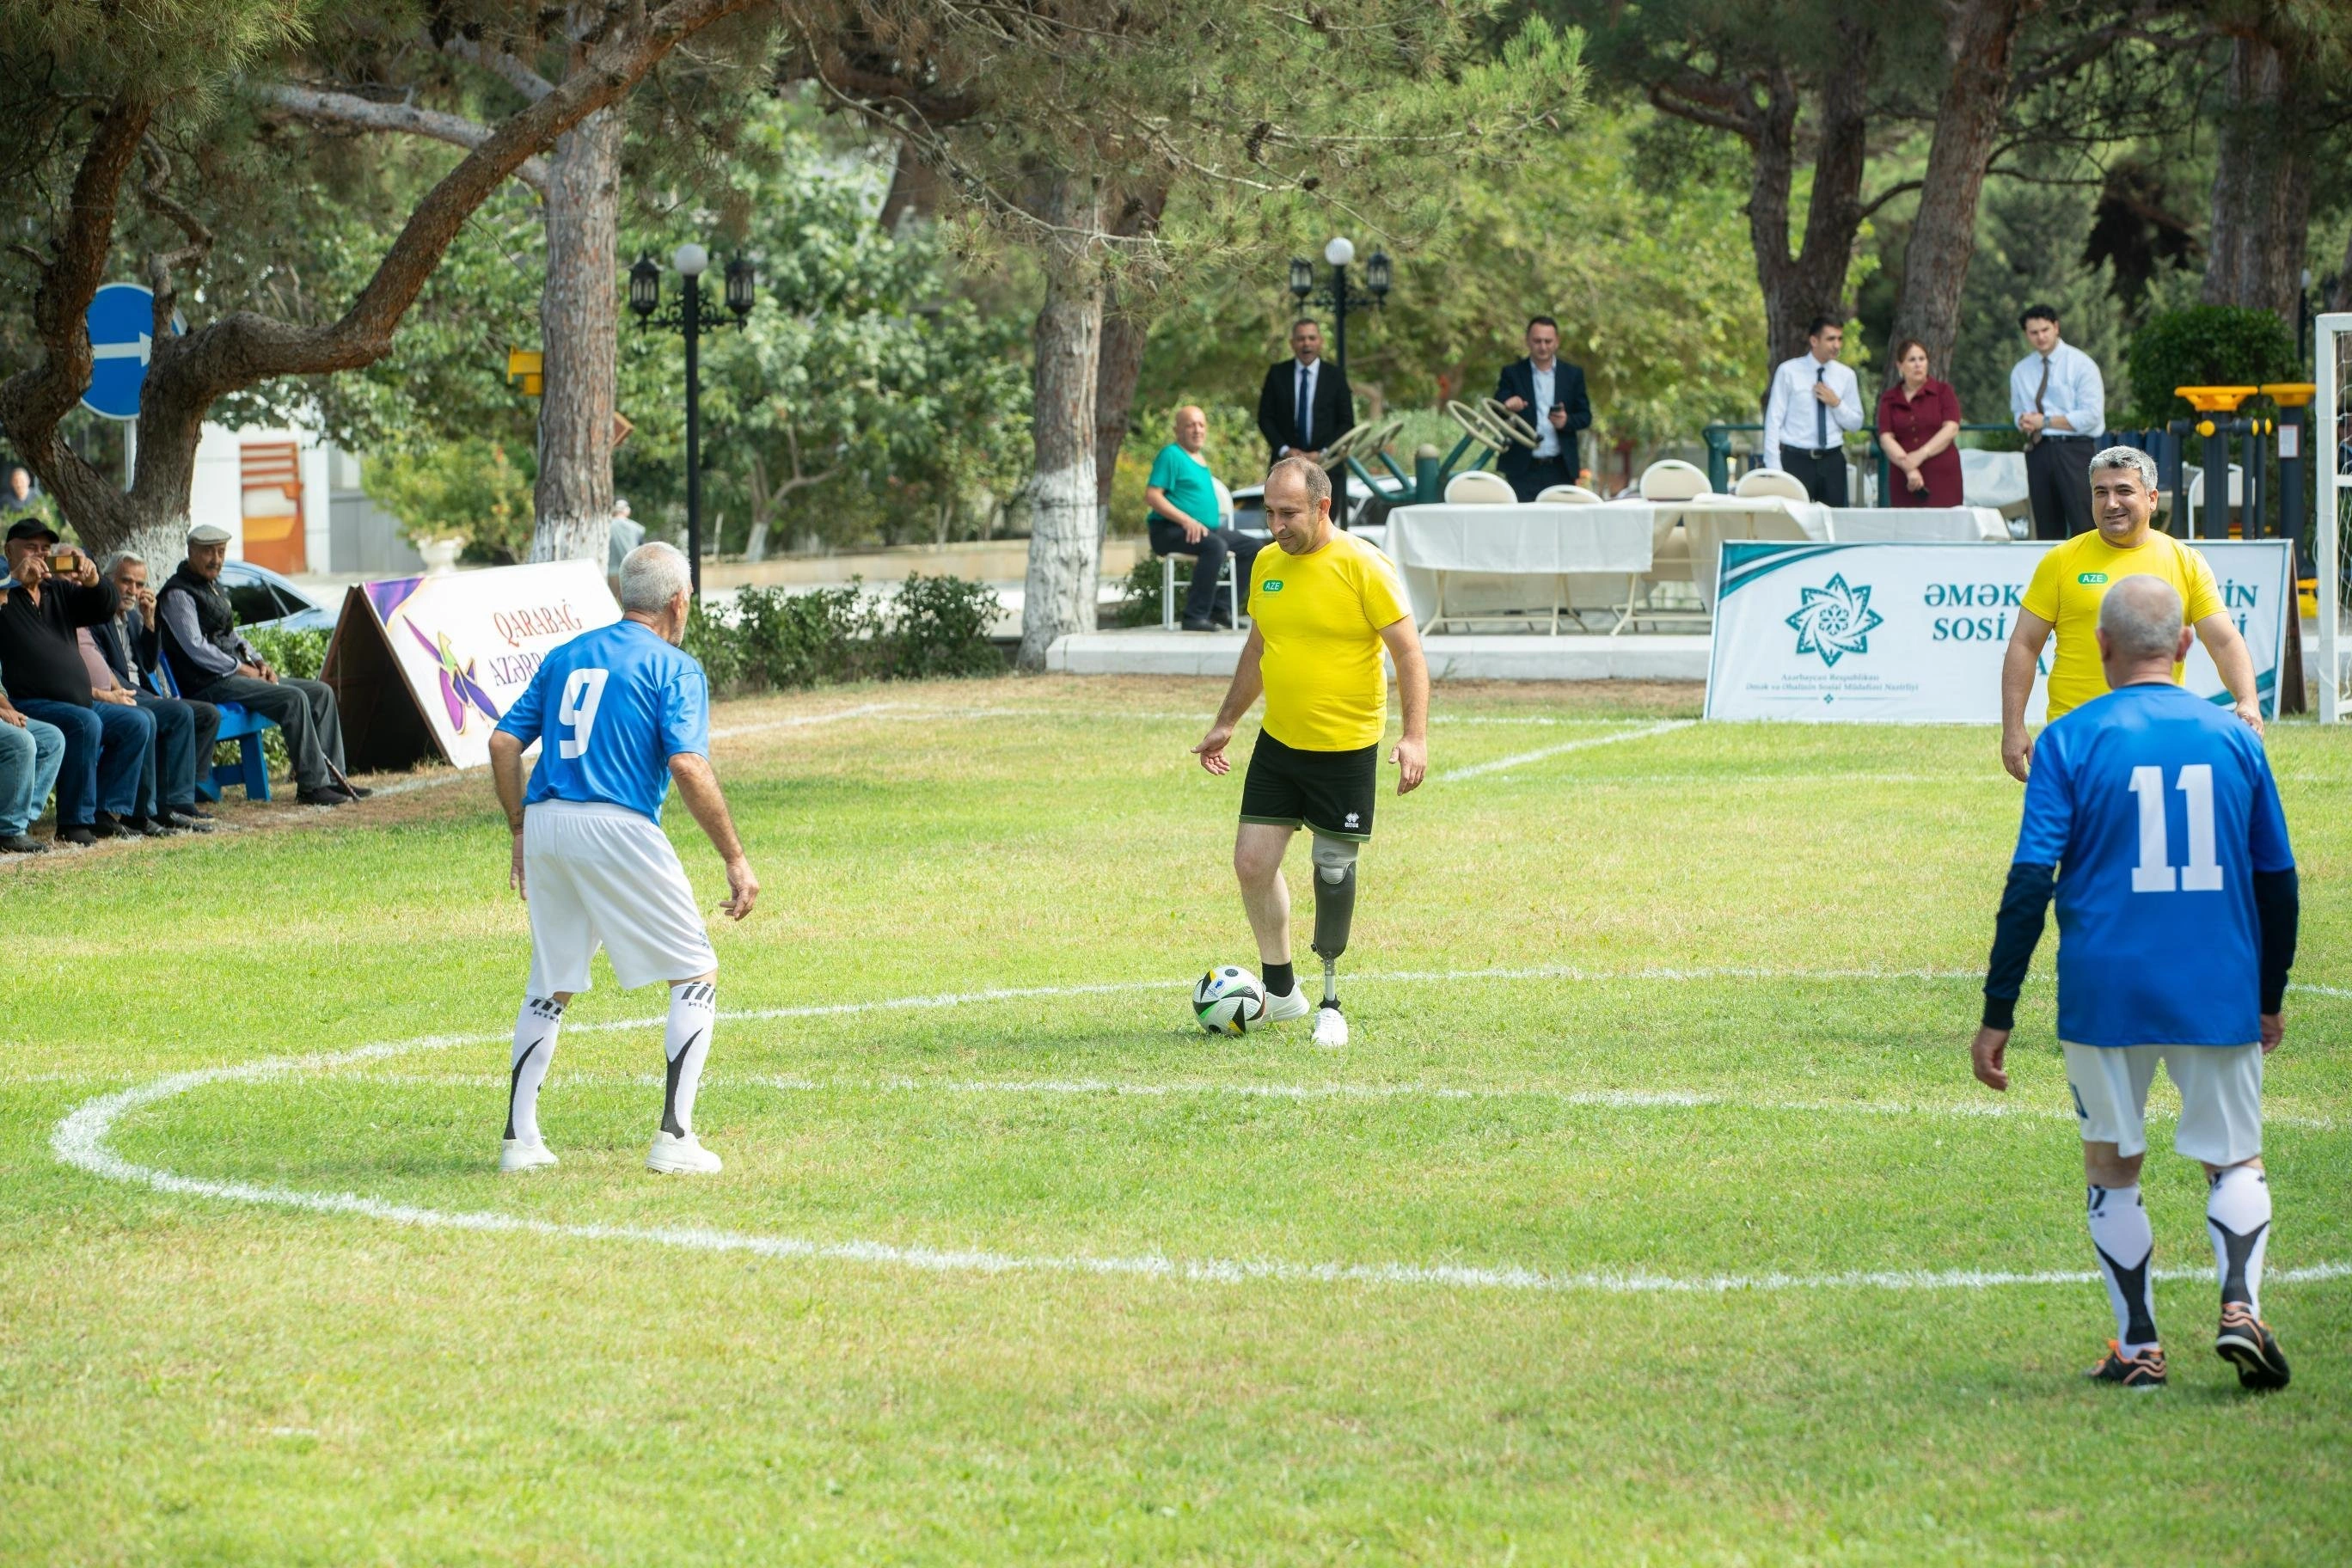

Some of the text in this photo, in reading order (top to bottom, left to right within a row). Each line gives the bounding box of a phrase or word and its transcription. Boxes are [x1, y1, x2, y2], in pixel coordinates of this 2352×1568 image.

[1265, 581, 1281, 591] AZE
[2082, 574, 2104, 583] AZE
[1924, 584, 2024, 607] ƏMƏK
[493, 598, 583, 647] QARABAĞ
[1932, 612, 2011, 641] SOSİ
[559, 668, 609, 759] 9
[2128, 763, 2224, 892] 11
